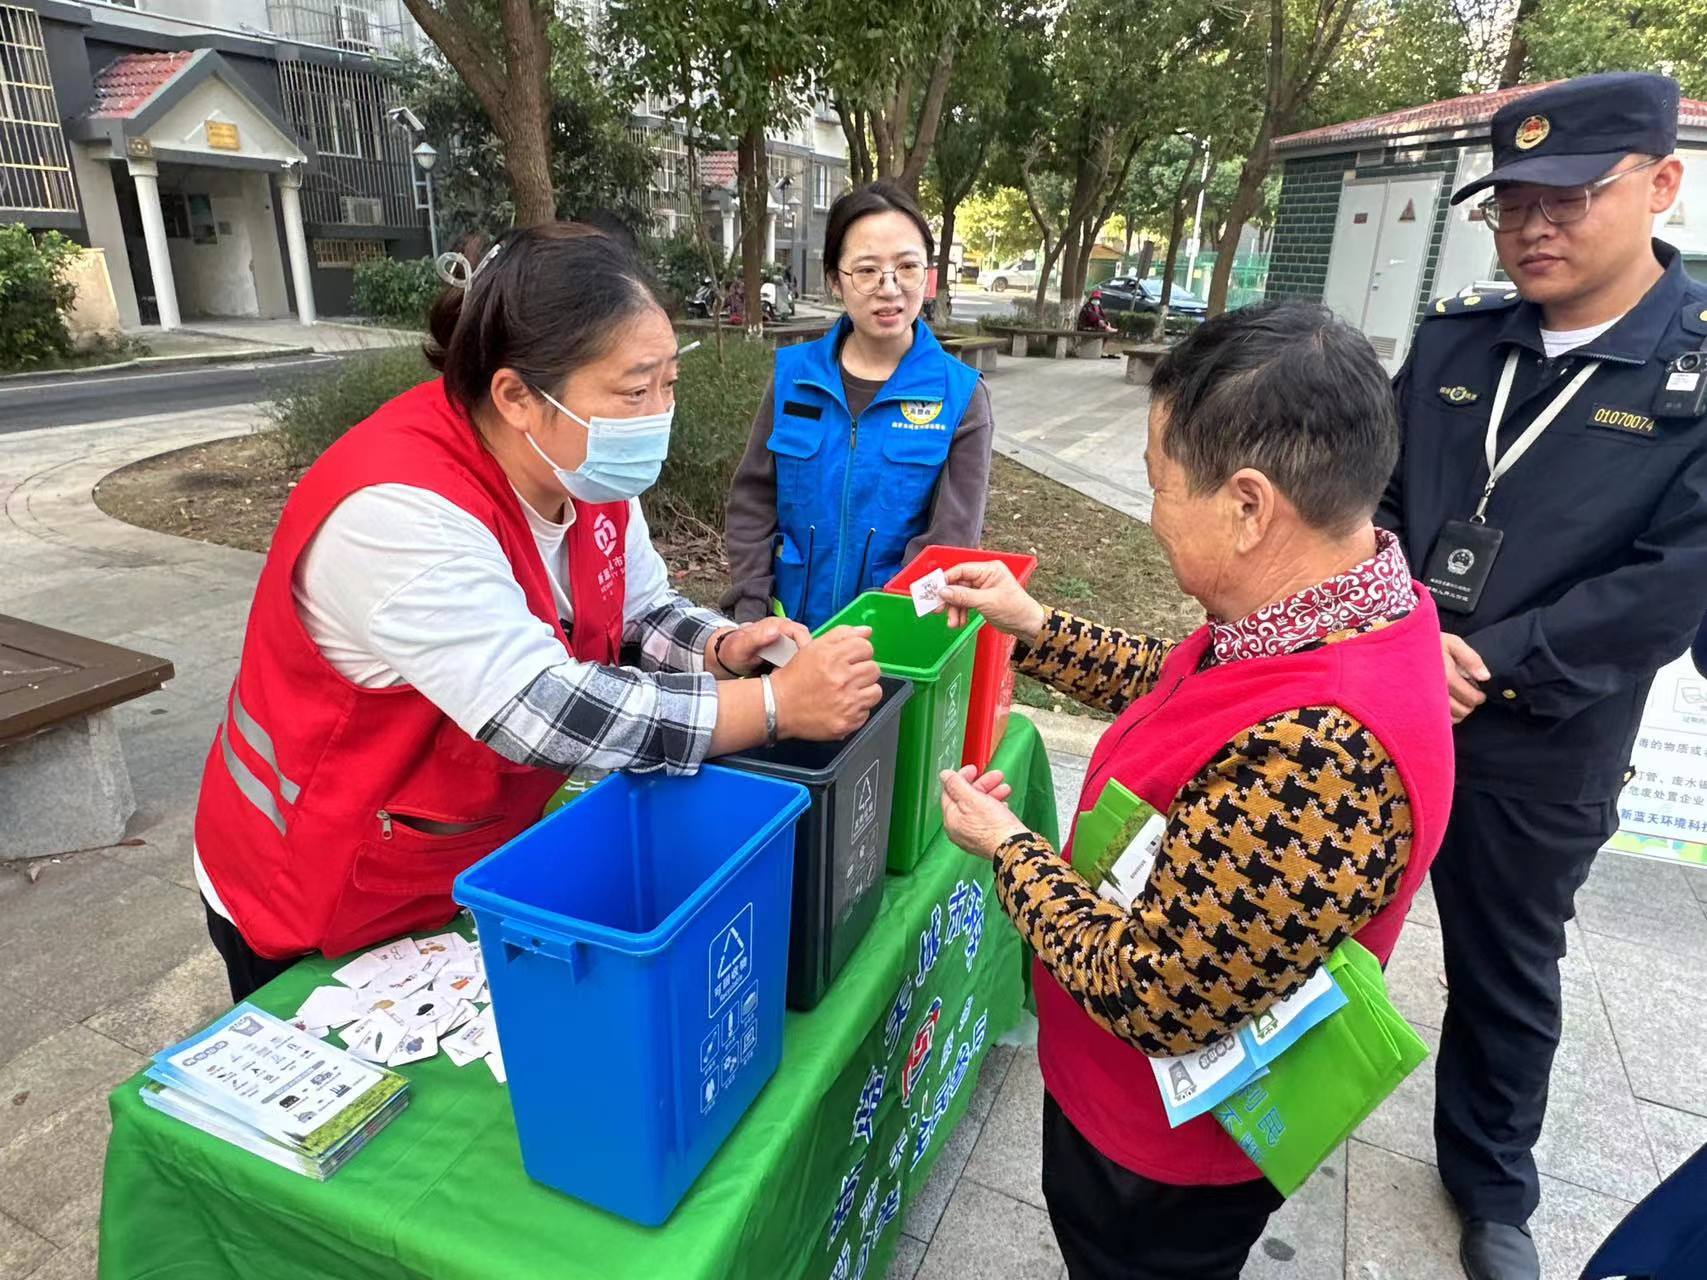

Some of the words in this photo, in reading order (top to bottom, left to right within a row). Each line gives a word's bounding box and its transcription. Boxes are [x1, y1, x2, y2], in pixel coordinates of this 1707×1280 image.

[1594, 408, 1655, 432] 01070074
[1621, 808, 1707, 832] 新蓝天环境科
